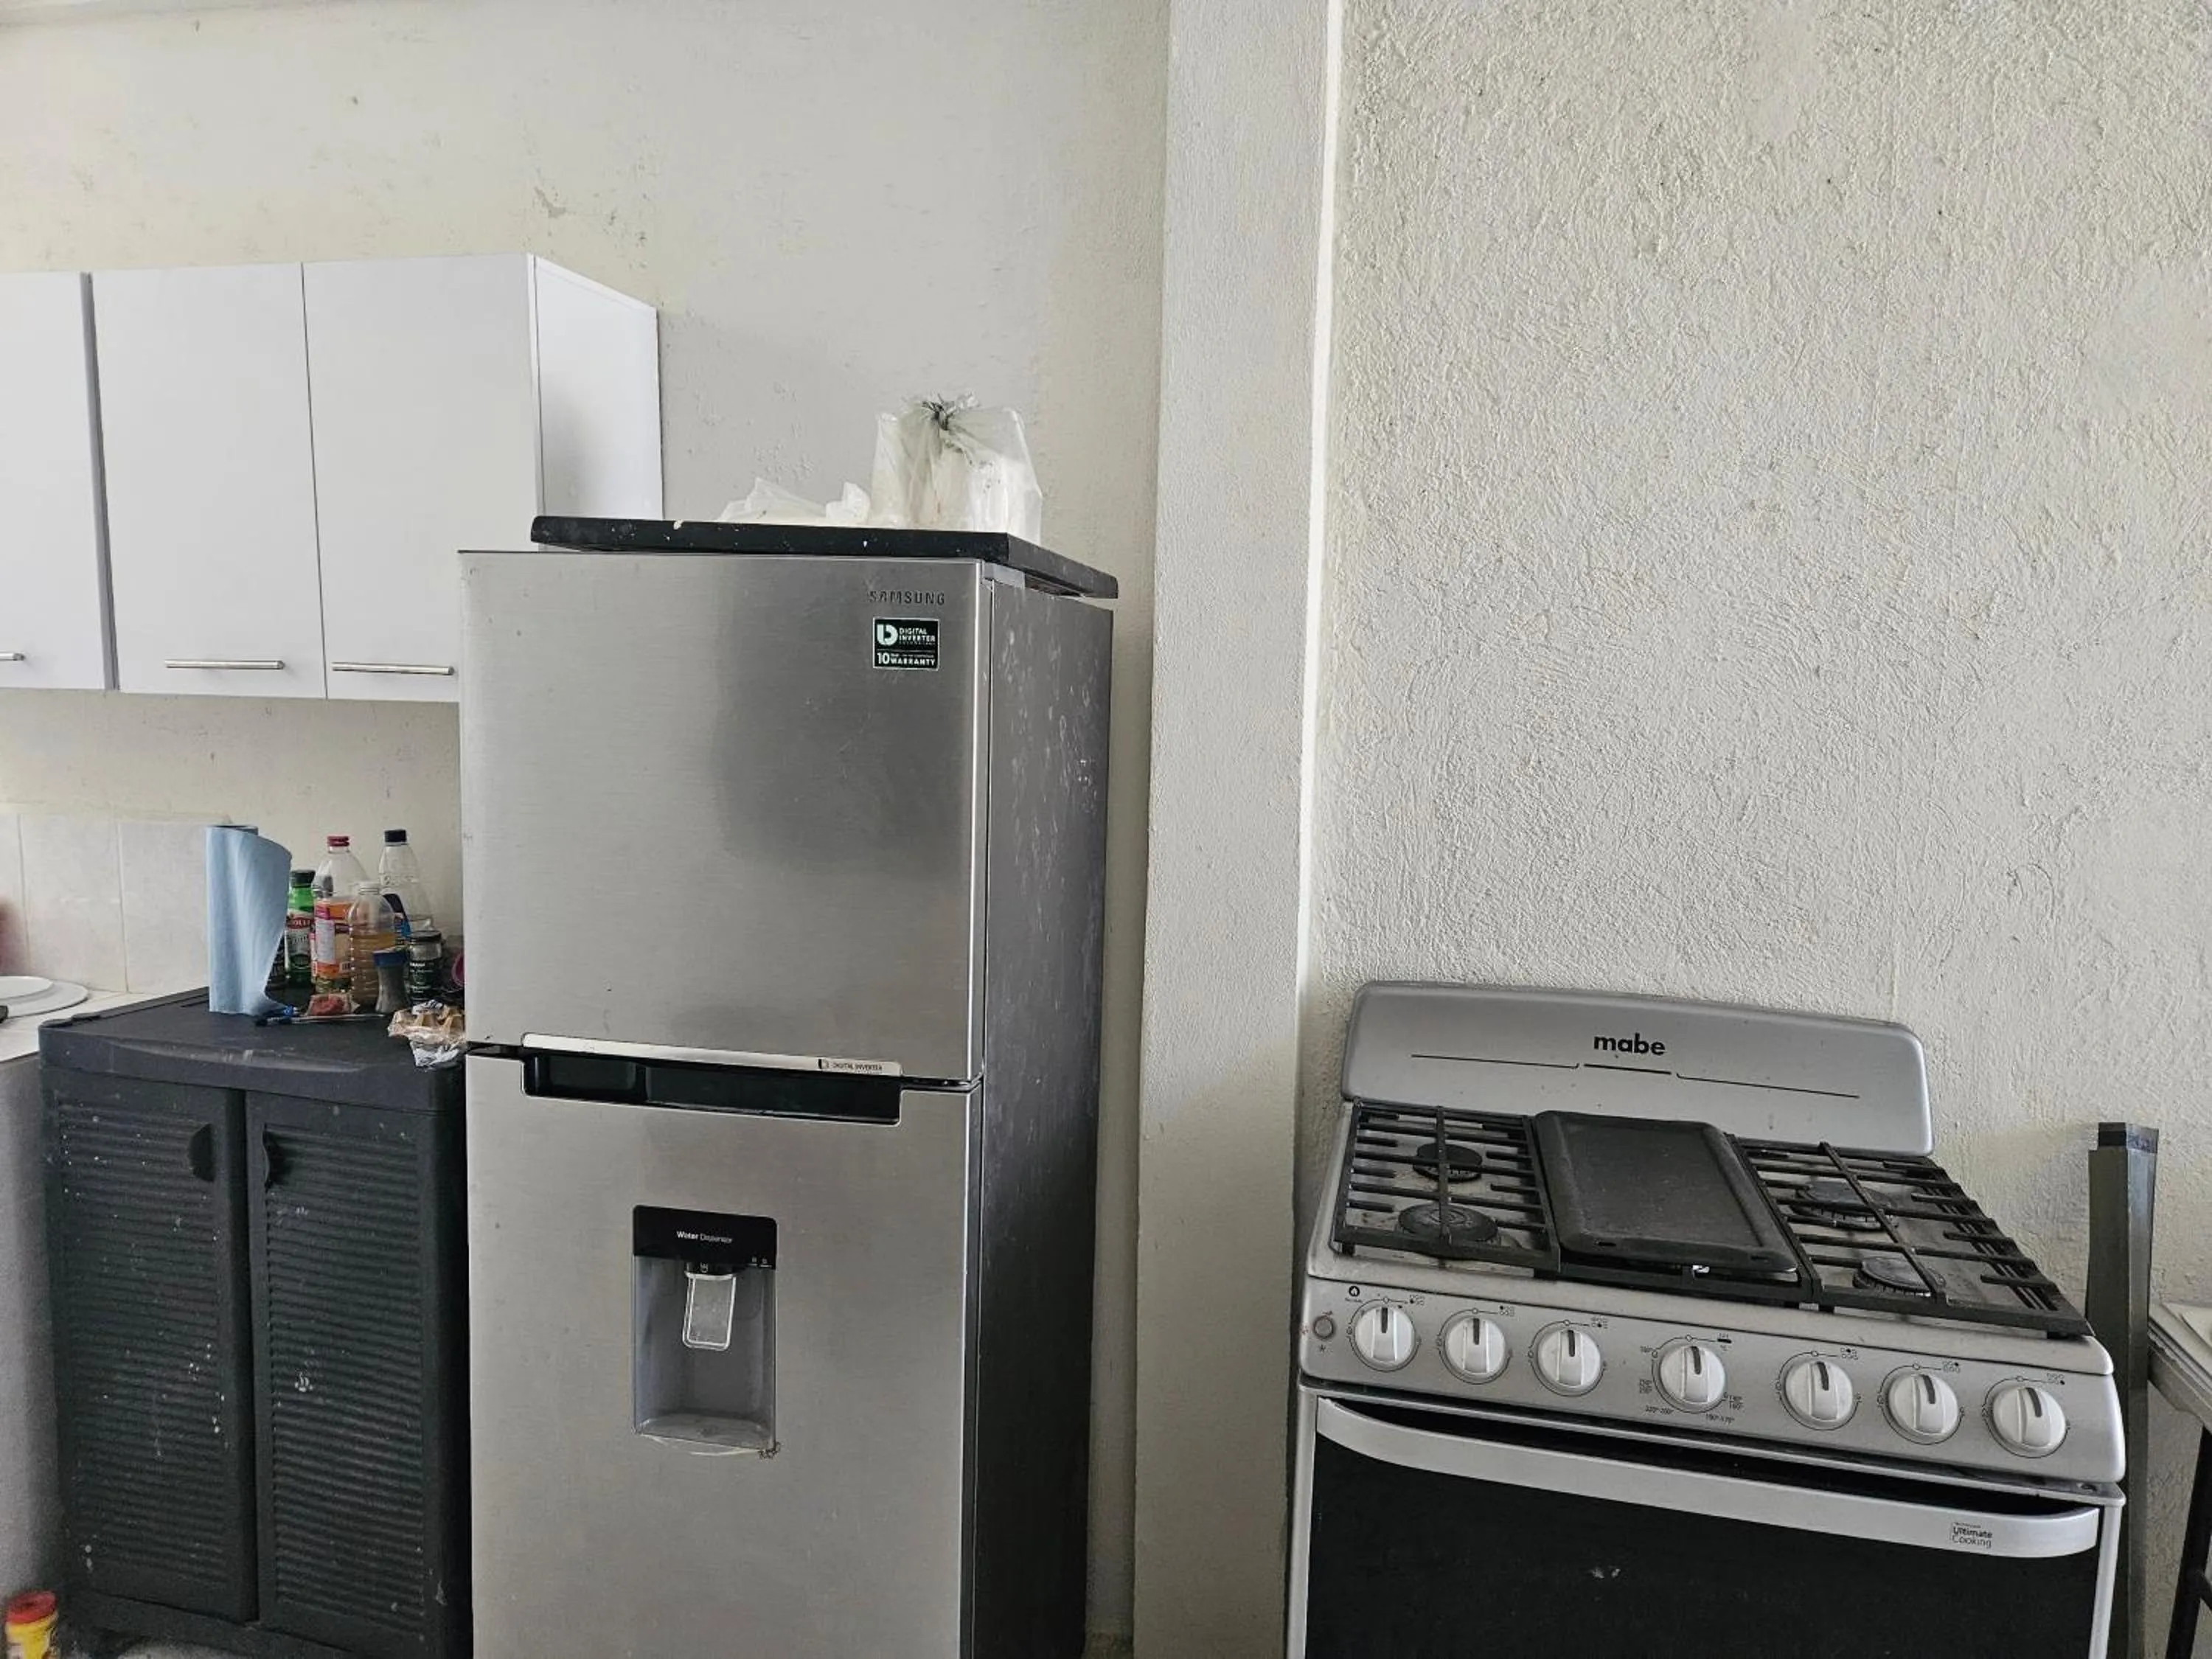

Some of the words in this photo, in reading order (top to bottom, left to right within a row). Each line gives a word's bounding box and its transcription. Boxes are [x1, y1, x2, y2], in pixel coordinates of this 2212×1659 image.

[869, 591, 945, 605] SAMSUNG
[877, 652, 890, 664] 10
[890, 658, 936, 666] WARRANTY
[1593, 1032, 1666, 1055] mabe
[677, 1231, 698, 1239] Water
[1952, 1526, 1993, 1539] Ultimate
[1952, 1534, 1992, 1549] Cooking
